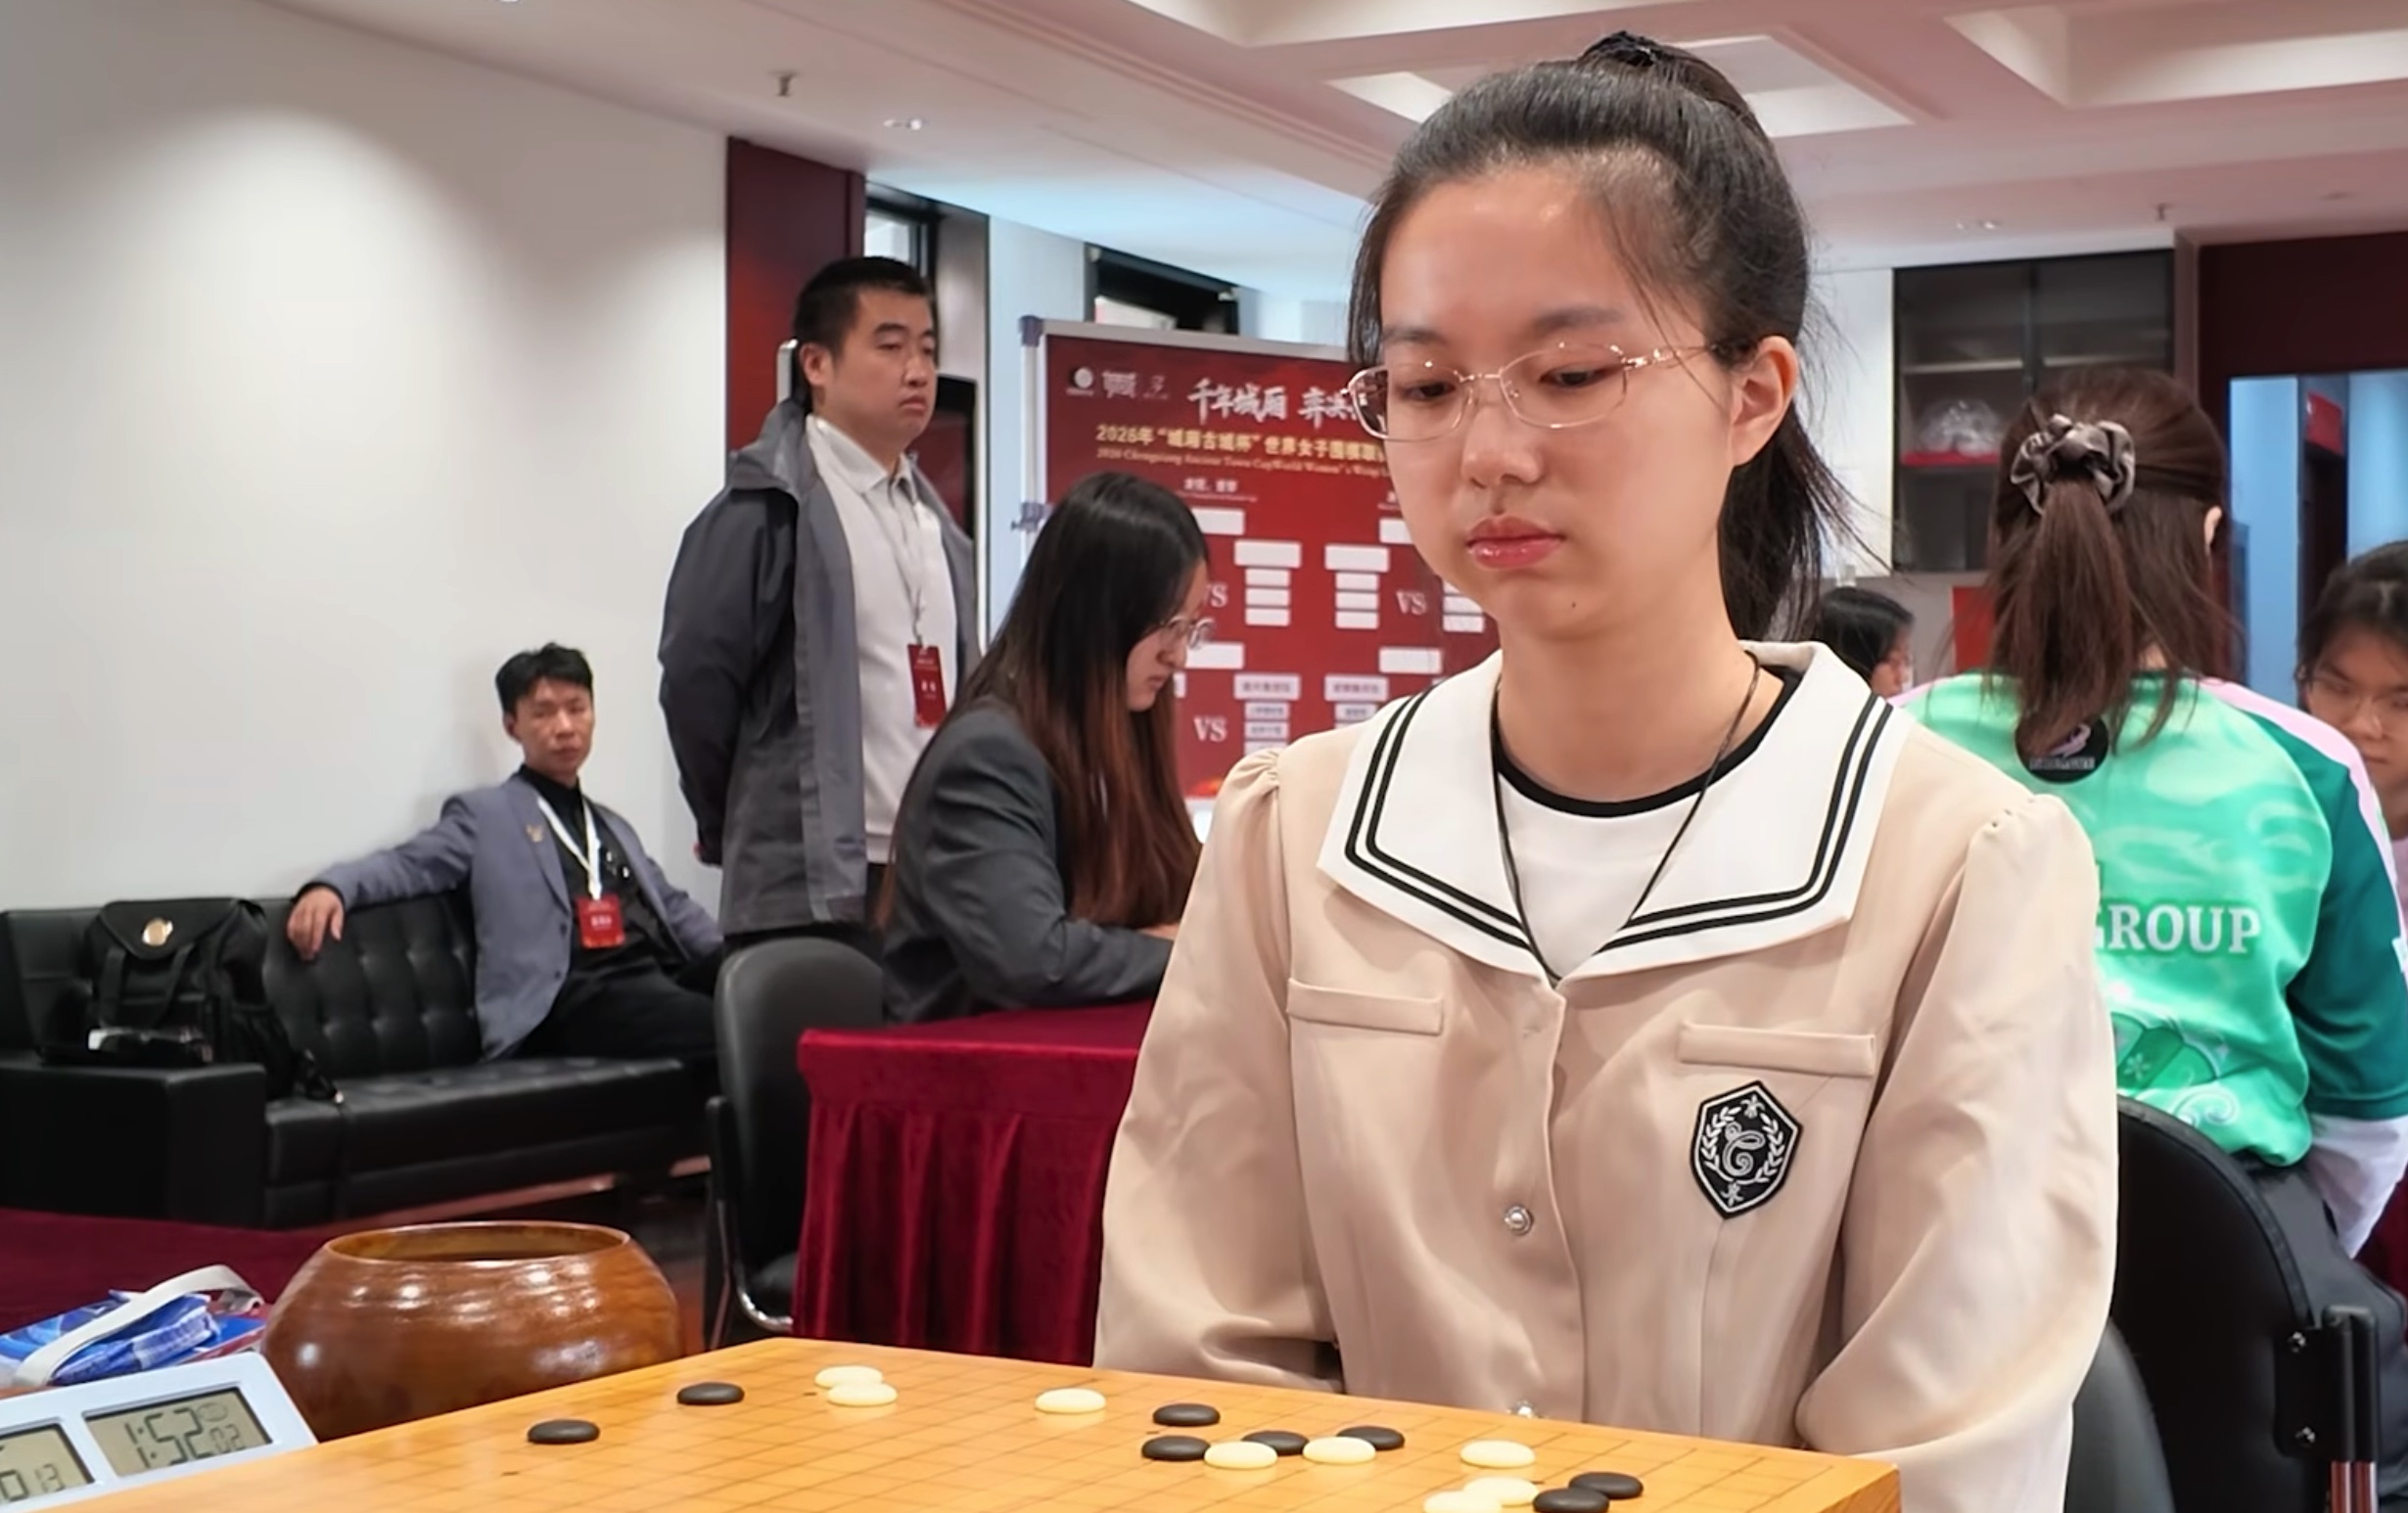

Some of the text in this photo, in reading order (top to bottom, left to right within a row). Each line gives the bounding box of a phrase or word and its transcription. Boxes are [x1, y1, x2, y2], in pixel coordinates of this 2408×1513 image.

[1396, 590, 1427, 616] VS
[1193, 715, 1227, 742] VS
[2094, 903, 2261, 953] ROUP
[124, 1406, 204, 1469] 1:52
